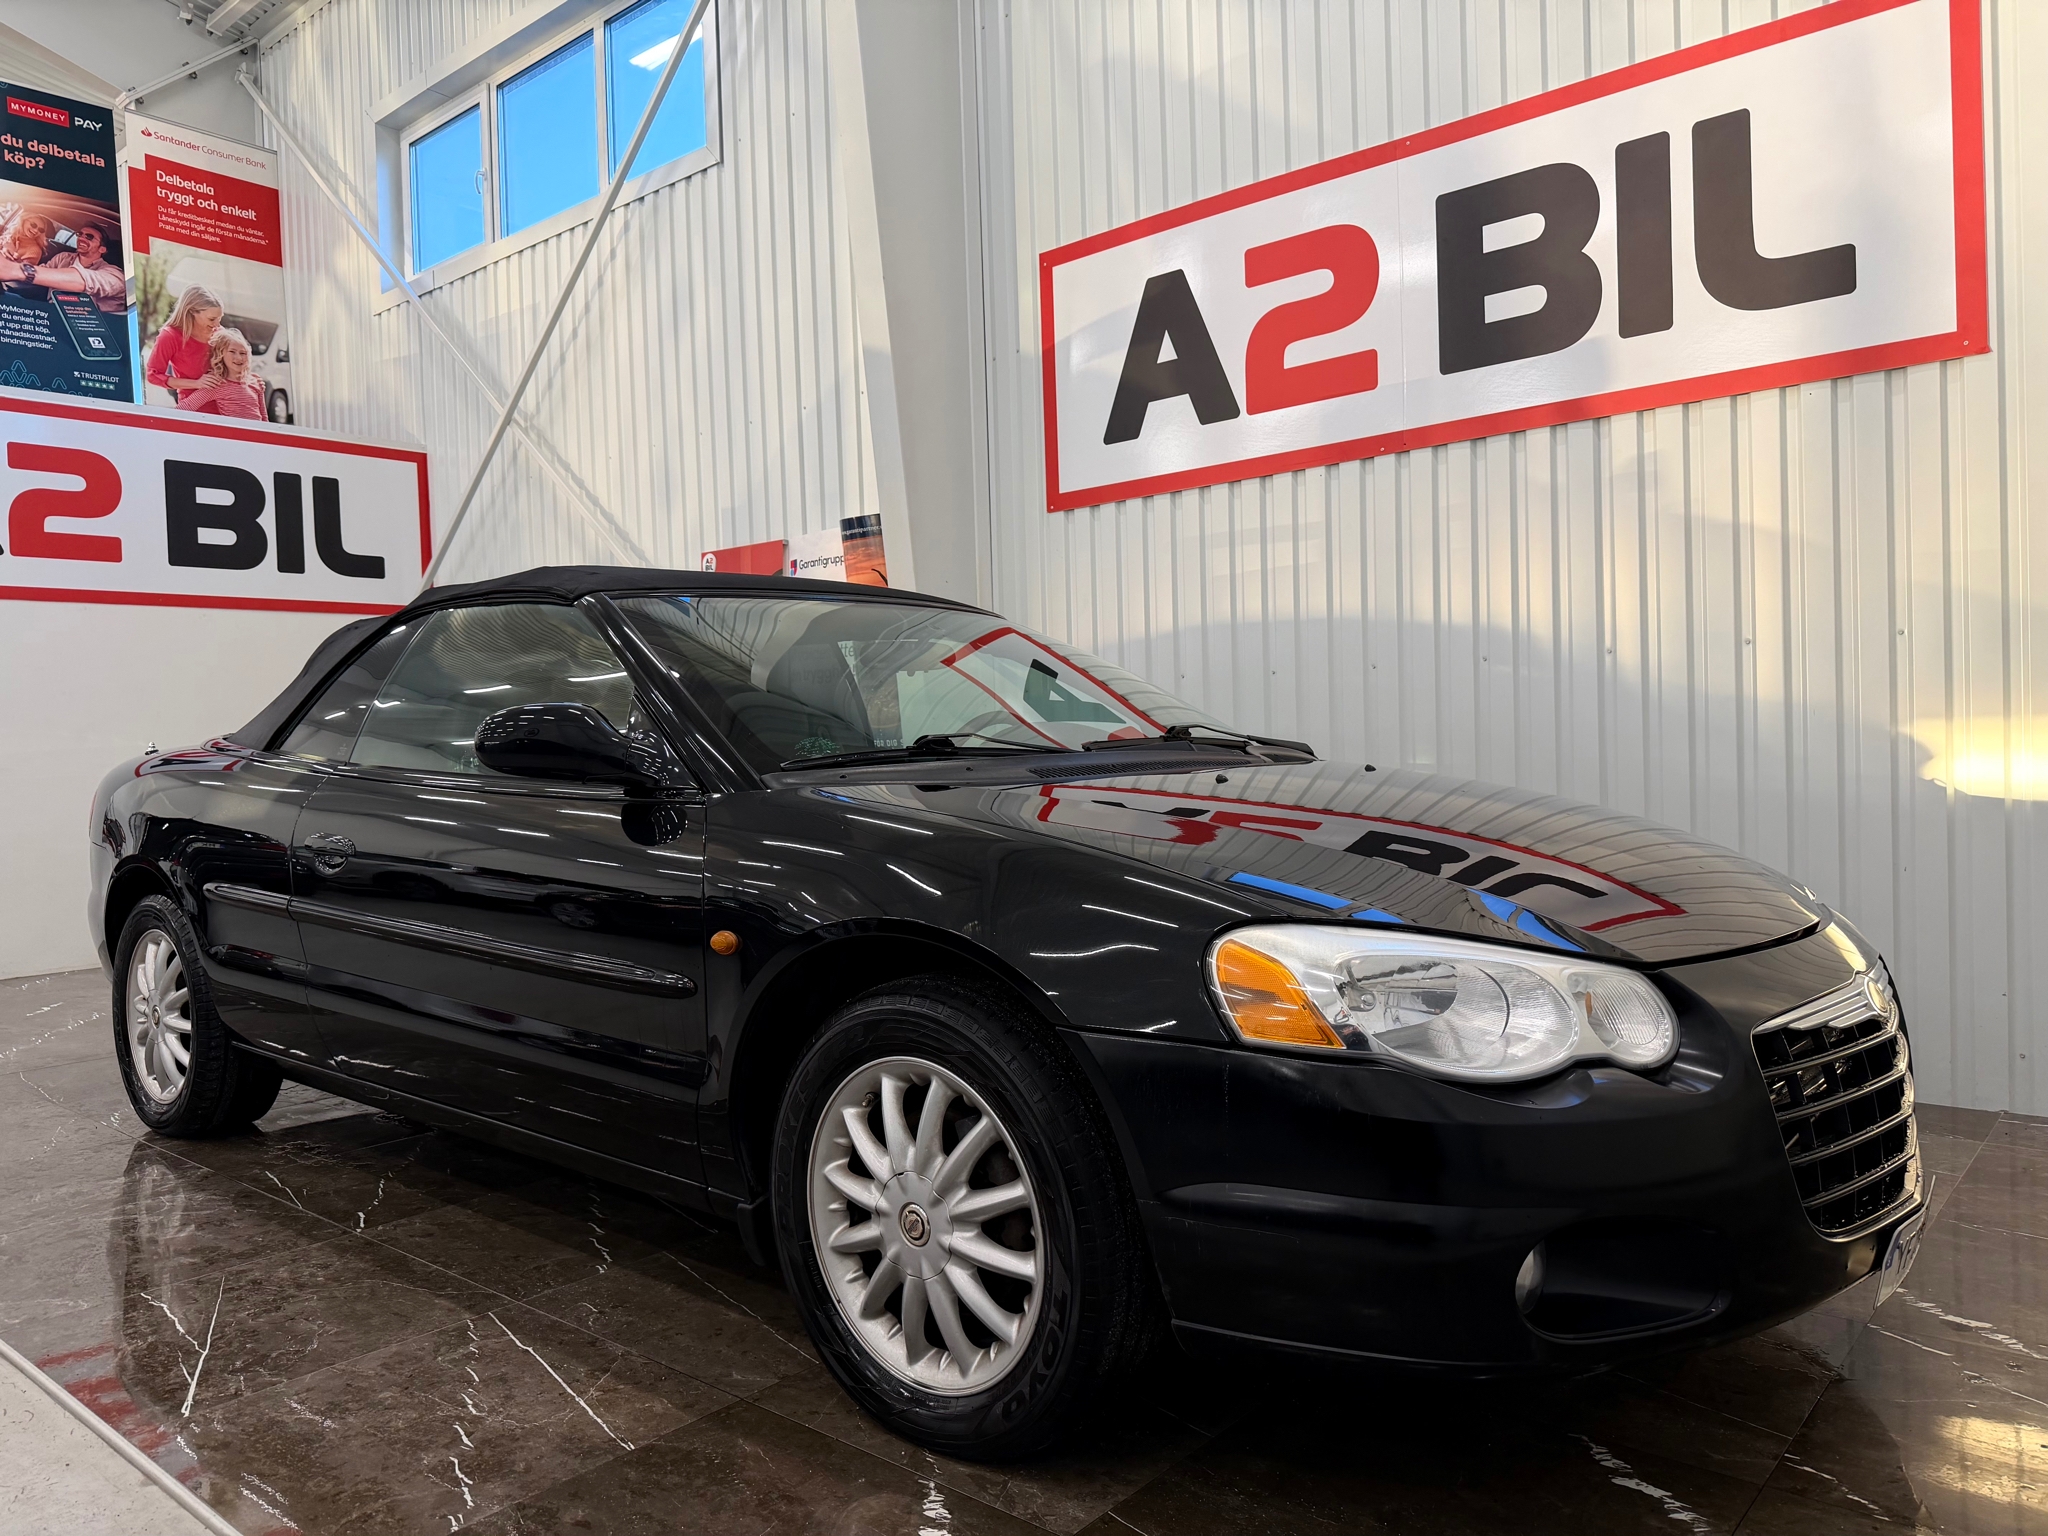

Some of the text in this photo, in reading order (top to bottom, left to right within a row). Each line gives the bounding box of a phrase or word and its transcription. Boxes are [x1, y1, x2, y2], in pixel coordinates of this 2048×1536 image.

[11, 102, 103, 132] MYMONEY PAY
[0, 133, 106, 168] du delbetala
[4, 149, 46, 170] köp?
[153, 131, 267, 170] Santander Consumer Bank
[156, 169, 215, 196] Delbetala
[156, 186, 257, 221] tryggt och enkelt
[157, 205, 167, 213] Du
[215, 219, 236, 231] medan
[236, 225, 245, 233] du
[158, 221, 176, 232] Prata
[175, 227, 190, 236] med
[1103, 108, 1857, 446] A2 BIL
[1, 312, 50, 326] du enkelt och
[6, 321, 21, 330] upp
[35, 309, 49, 319] Pay
[81, 372, 120, 384] TRUSTPILOT
[0, 441, 386, 580] 2 BIL
